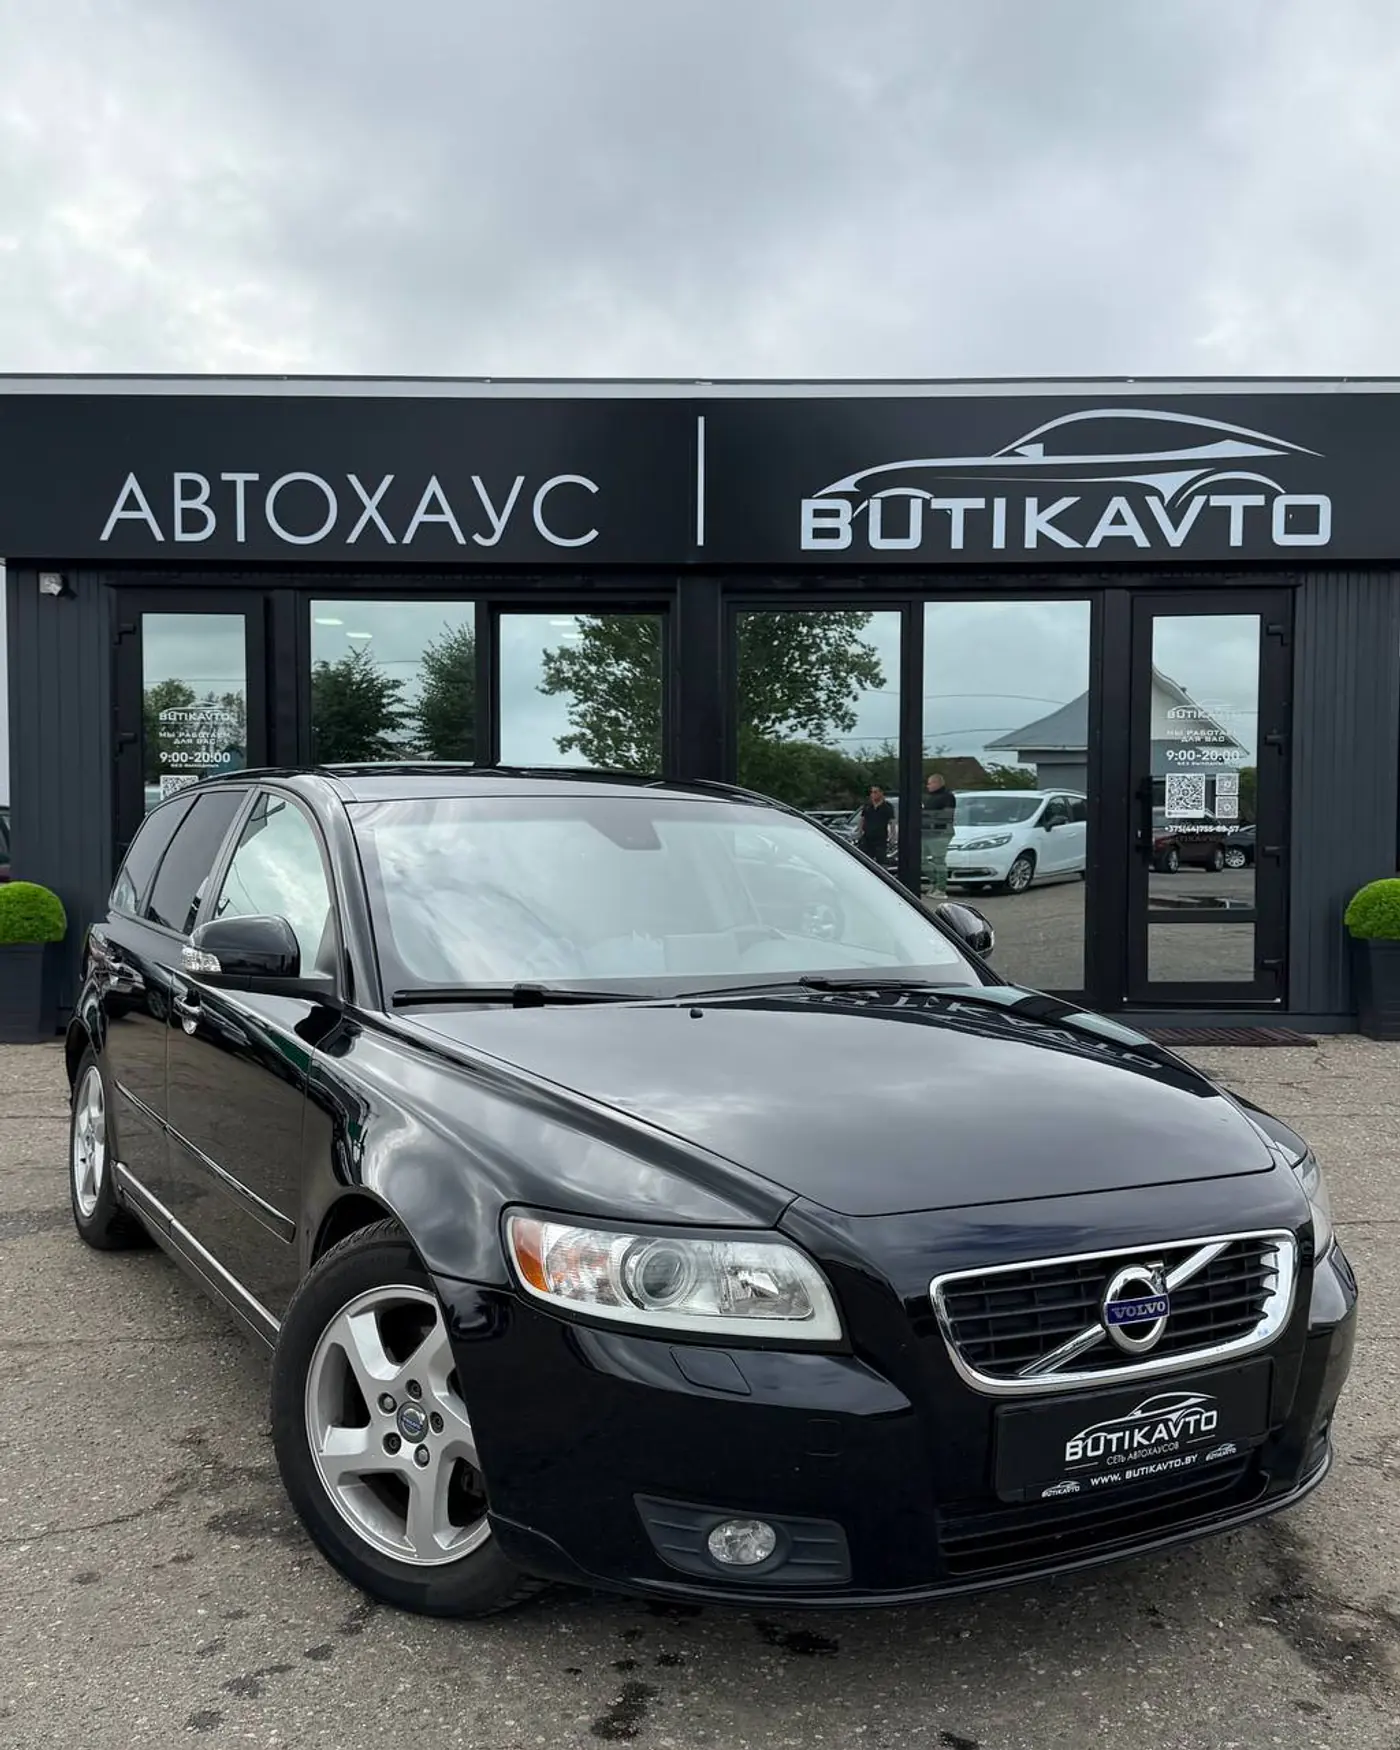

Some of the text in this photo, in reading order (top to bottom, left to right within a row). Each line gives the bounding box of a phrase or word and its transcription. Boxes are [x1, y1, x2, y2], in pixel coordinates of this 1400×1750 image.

[99, 471, 601, 547] АВТОХАУС
[800, 494, 1332, 551] BUTIKAVTO
[159, 712, 230, 721] BUTIKAVTO
[159, 751, 231, 763] 9:00-20:00
[1166, 749, 1240, 761] 9:00-20:00
[1111, 1300, 1166, 1319] VOLVO
[1065, 1410, 1218, 1462] BUTIKAVTO
[1106, 1441, 1180, 1466] СЕТЬ АВТОХАУСОВ
[1090, 1453, 1198, 1486] WWW. BUTIKAVTO.BY
[1041, 1486, 1080, 1498] BUTIKAVTO
